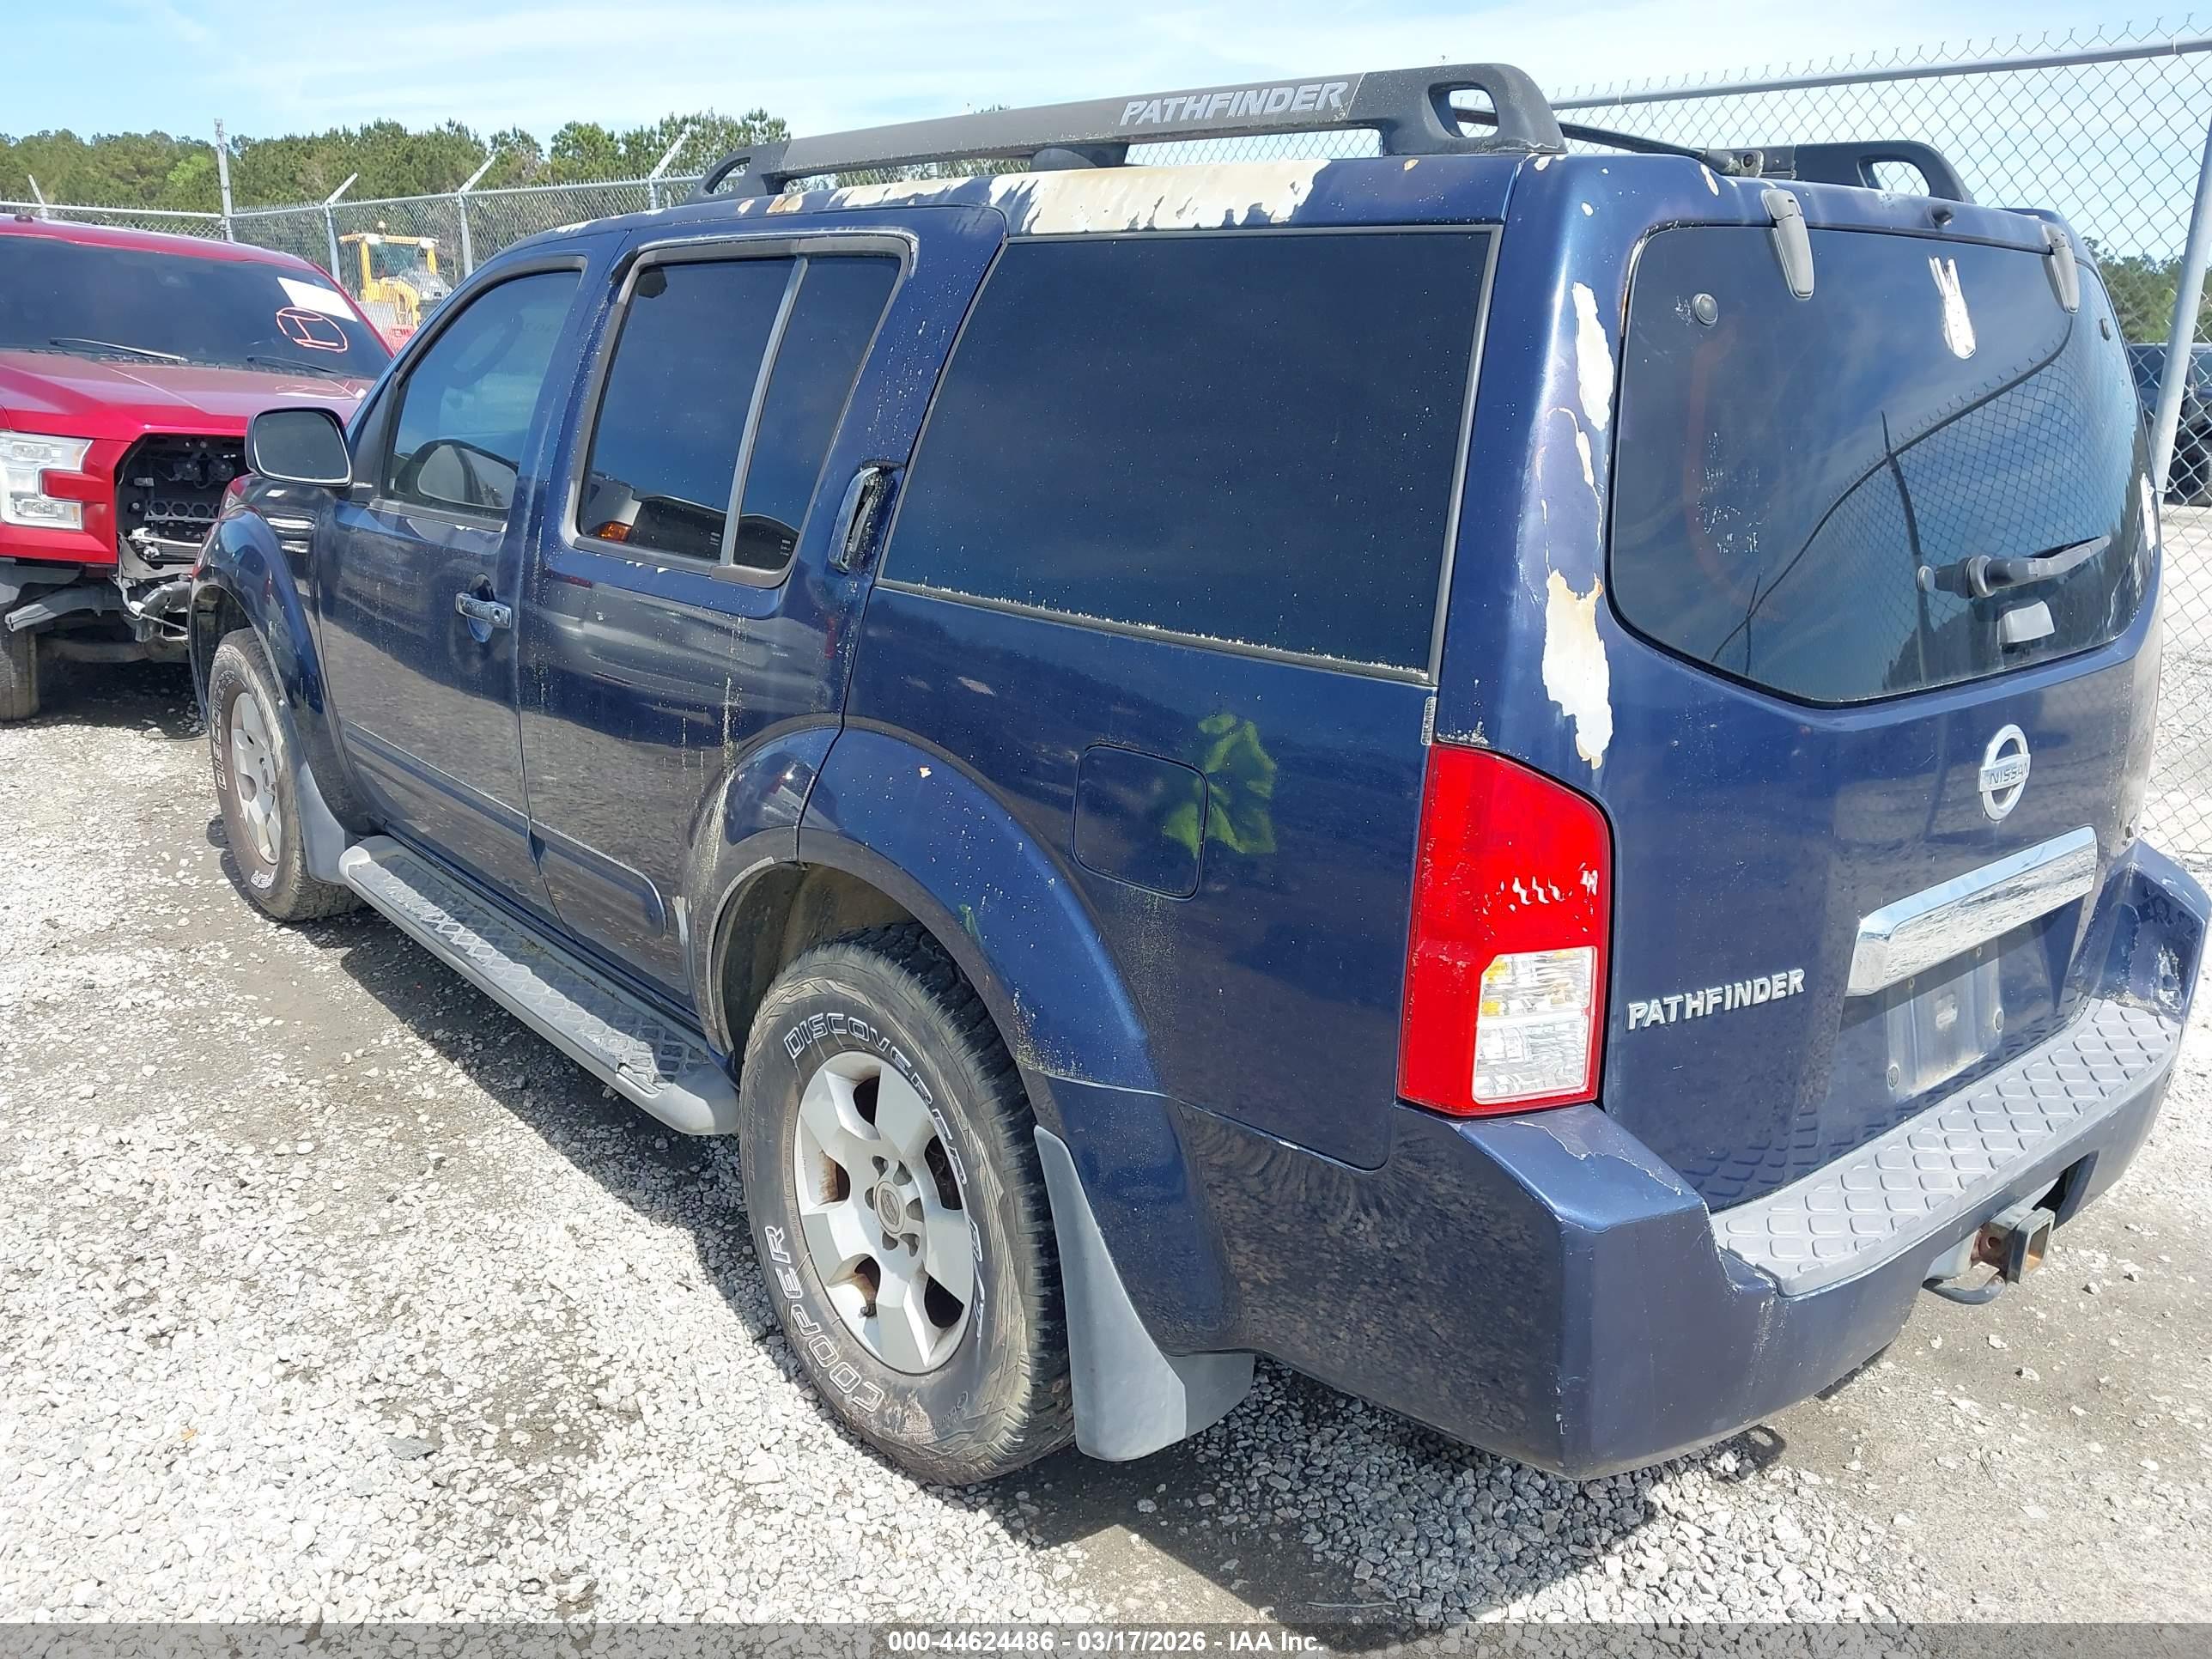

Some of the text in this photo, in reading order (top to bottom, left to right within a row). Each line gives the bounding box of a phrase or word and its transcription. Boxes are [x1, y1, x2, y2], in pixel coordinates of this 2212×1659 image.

[1120, 82, 1349, 126] PATHFINDER
[1990, 762, 2028, 785] NISSAN
[1627, 968, 1805, 1030] PATHFINDER
[783, 1012, 967, 1185] DISCOVERER
[765, 1225, 884, 1413] COOPER
